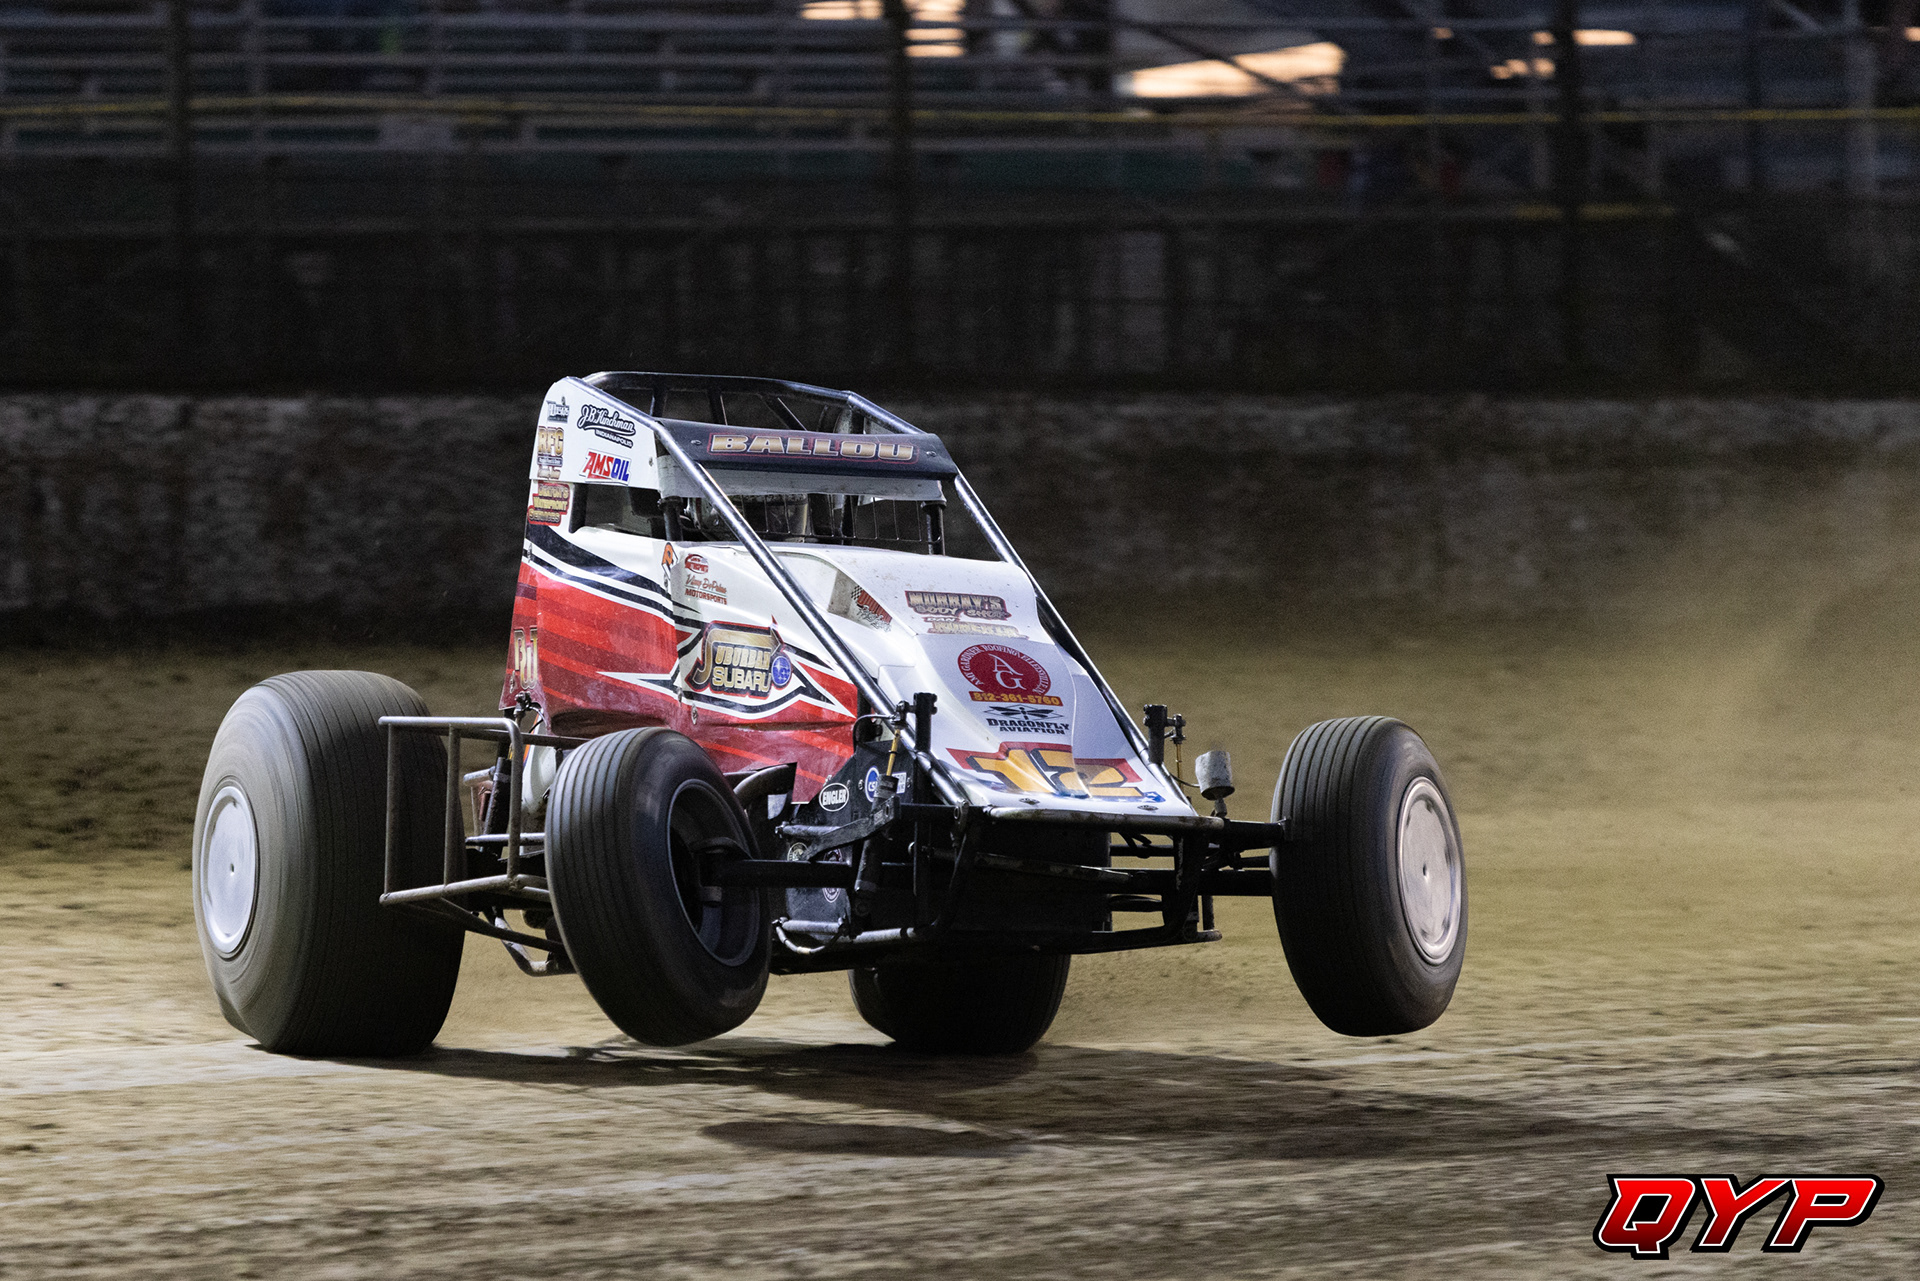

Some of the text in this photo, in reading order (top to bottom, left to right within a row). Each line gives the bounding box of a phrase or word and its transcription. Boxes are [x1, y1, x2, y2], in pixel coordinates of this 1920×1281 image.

[710, 434, 914, 461] BALLOU
[582, 451, 630, 480] AMSOIL
[685, 588, 728, 605] MOTORSPORTS
[908, 592, 1002, 611] MURRAY'S
[712, 666, 772, 692] SUBARU
[986, 718, 1070, 730] DRAGONFLY
[1000, 726, 1065, 735] AVIATION
[966, 748, 1144, 798] 12
[823, 789, 847, 806] ENGLER
